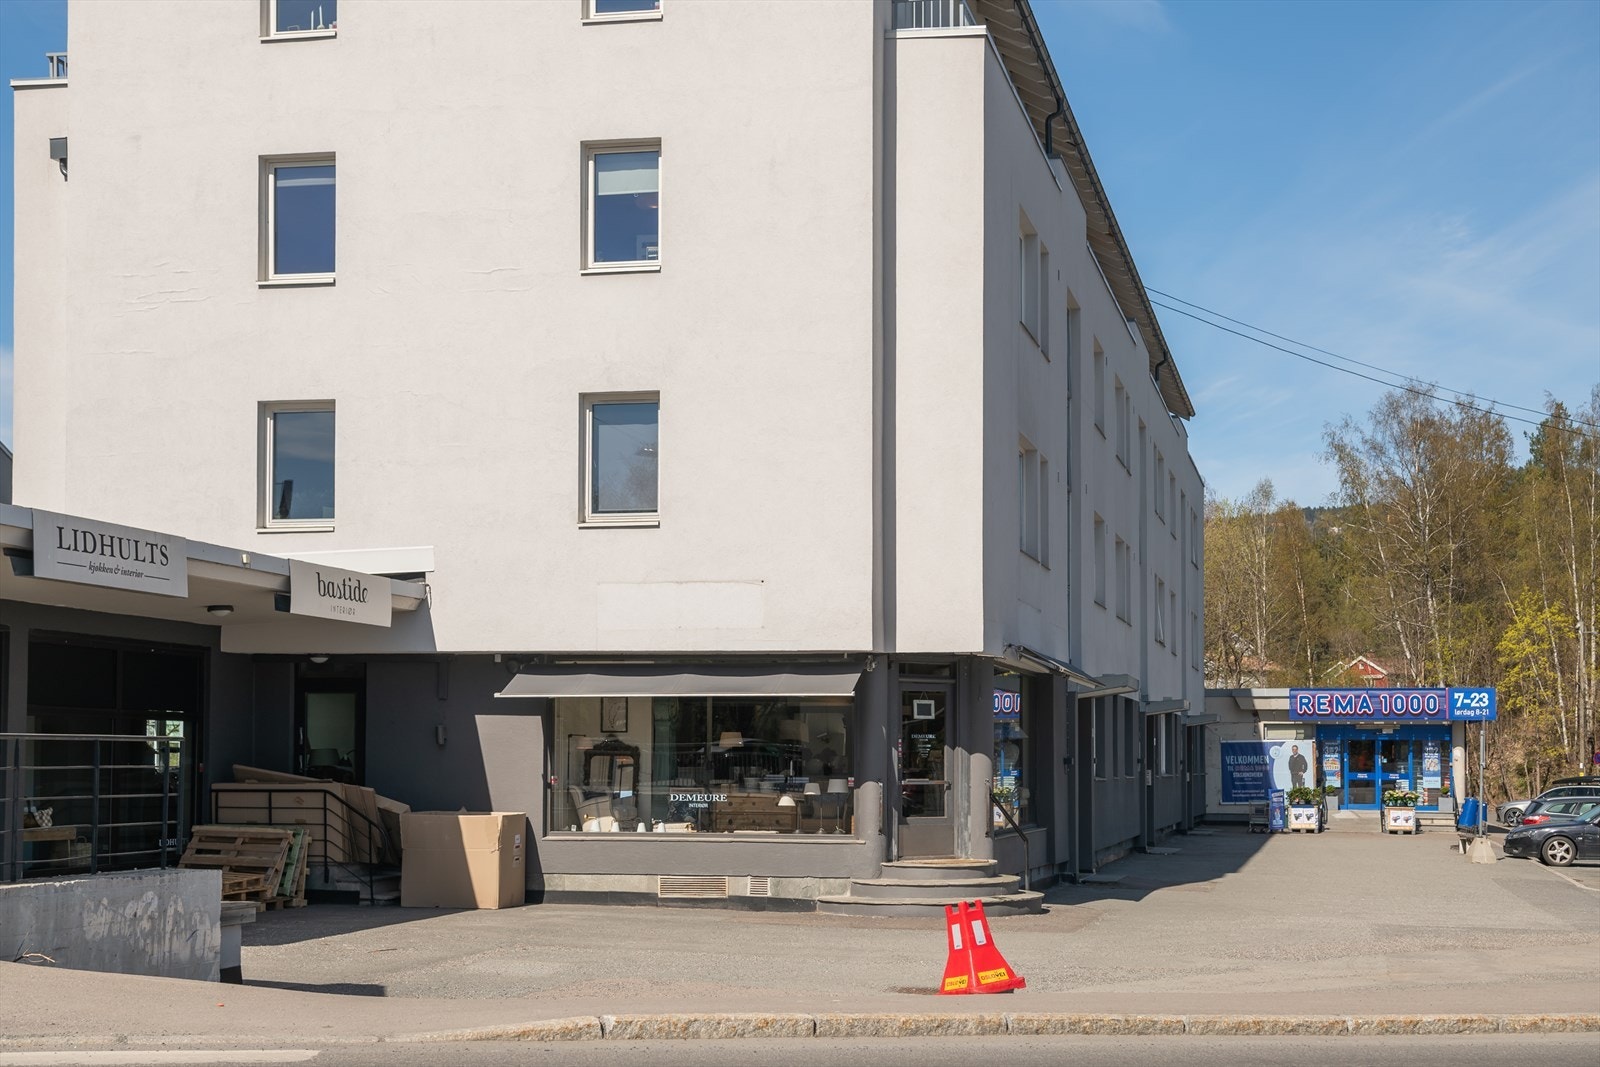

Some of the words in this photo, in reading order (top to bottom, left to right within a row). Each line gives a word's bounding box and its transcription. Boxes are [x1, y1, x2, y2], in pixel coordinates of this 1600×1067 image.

[56, 525, 169, 566] LIDHULTS
[114, 564, 121, 575] &
[315, 571, 369, 604] bastide
[1297, 694, 1374, 715] REMA
[1380, 694, 1439, 714] 1000
[1454, 692, 1489, 708] 7-23
[1475, 708, 1489, 716] 8-21
[1225, 755, 1270, 765] VELKOMMEN
[670, 793, 728, 802] DEMEURE
